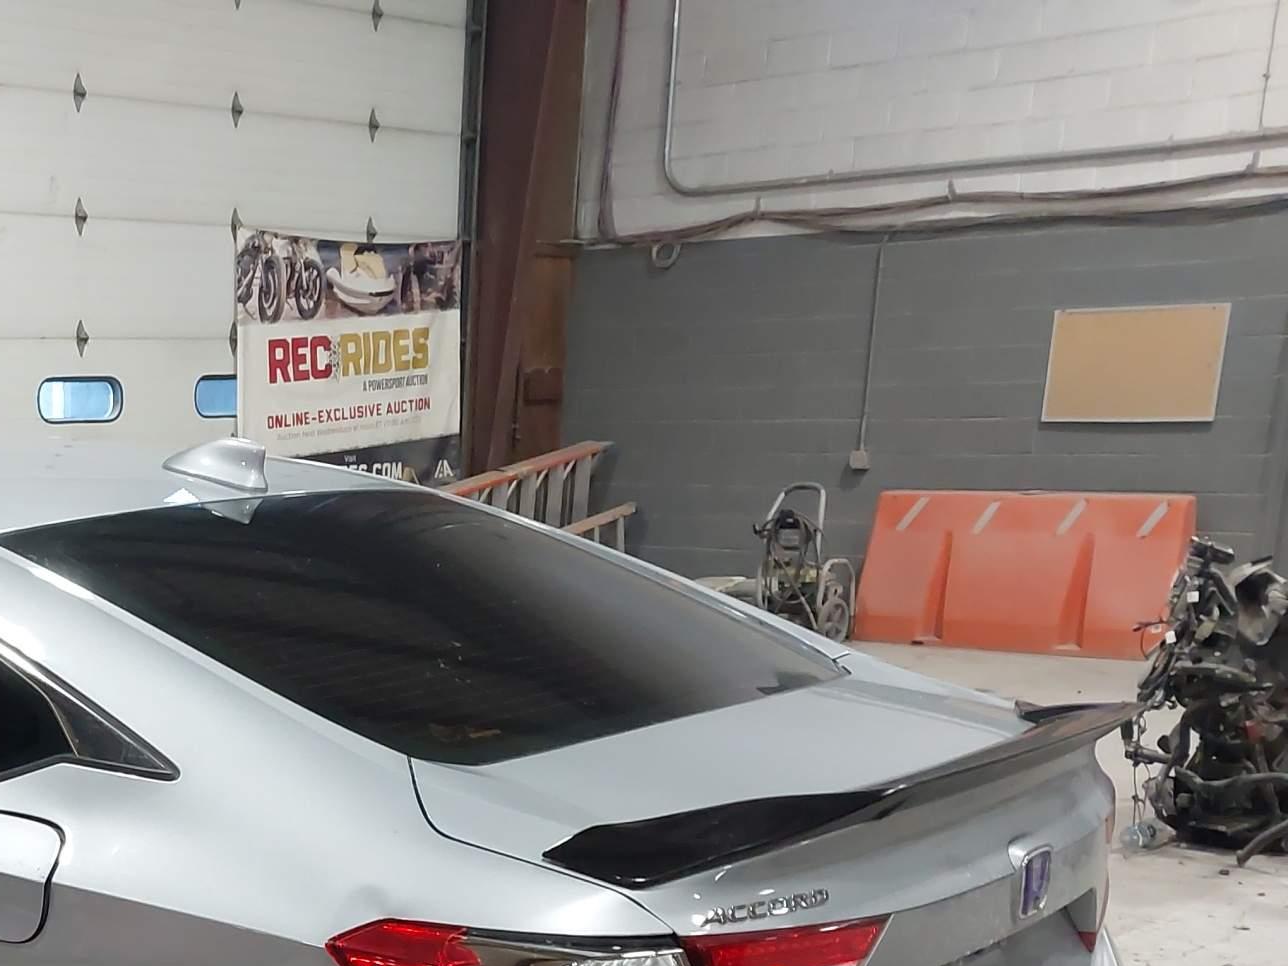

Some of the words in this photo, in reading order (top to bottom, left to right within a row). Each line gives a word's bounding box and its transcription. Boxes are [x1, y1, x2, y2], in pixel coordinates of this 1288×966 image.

[267, 335, 333, 384] REC
[339, 327, 431, 378] RIDES
[362, 380, 368, 392] A
[368, 376, 406, 392] POWERSPORT
[406, 373, 429, 387] AUCTION
[267, 403, 382, 430] ONLINE-EXCLUSIVE
[386, 397, 431, 416] AUCTION
[699, 887, 830, 928] ACCORD
